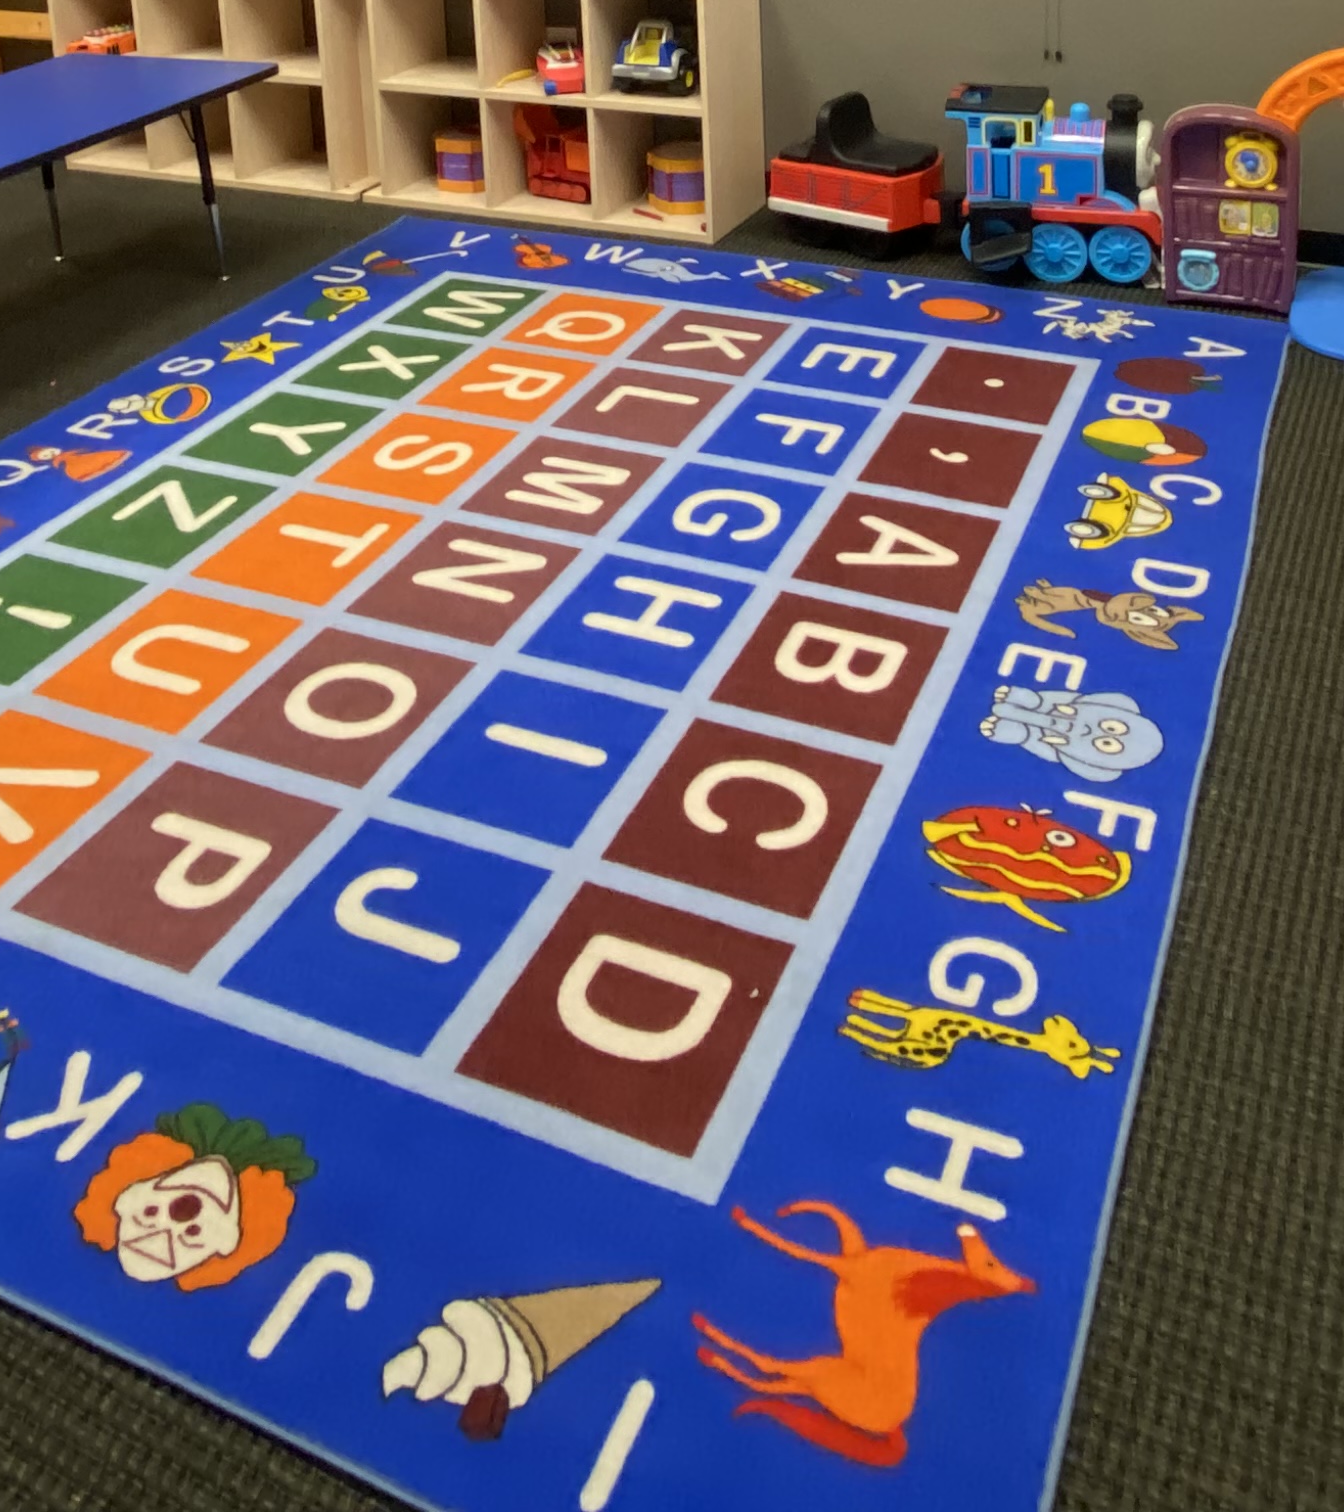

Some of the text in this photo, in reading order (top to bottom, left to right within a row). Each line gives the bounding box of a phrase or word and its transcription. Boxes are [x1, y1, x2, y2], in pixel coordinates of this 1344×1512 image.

[1037, 163, 1057, 196] 1
[421, 289, 526, 330] W
[450, 231, 1084, 318] V W X Y Z
[66, 413, 138, 441] R
[158, 356, 215, 377] S
[262, 311, 314, 327] T
[312, 265, 366, 284] U
[337, 344, 441, 381] X
[524, 309, 627, 344] Q
[459, 362, 566, 402] R
[247, 420, 348, 457] Y
[372, 433, 474, 476] S
[110, 479, 239, 534] Z
[835, 514, 960, 567] A
[278, 522, 390, 569] T
[150, 323, 764, 910] K L M N O P
[335, 343, 896, 963] E F G H I J
[109, 623, 251, 696] U
[773, 620, 909, 694] B
[682, 758, 829, 851] C
[885, 336, 1246, 1221] A B C D E F G H
[556, 933, 733, 1062] D
[5, 1051, 142, 1162] K
[249, 1252, 374, 1359] J
[580, 1380, 654, 1512] I
